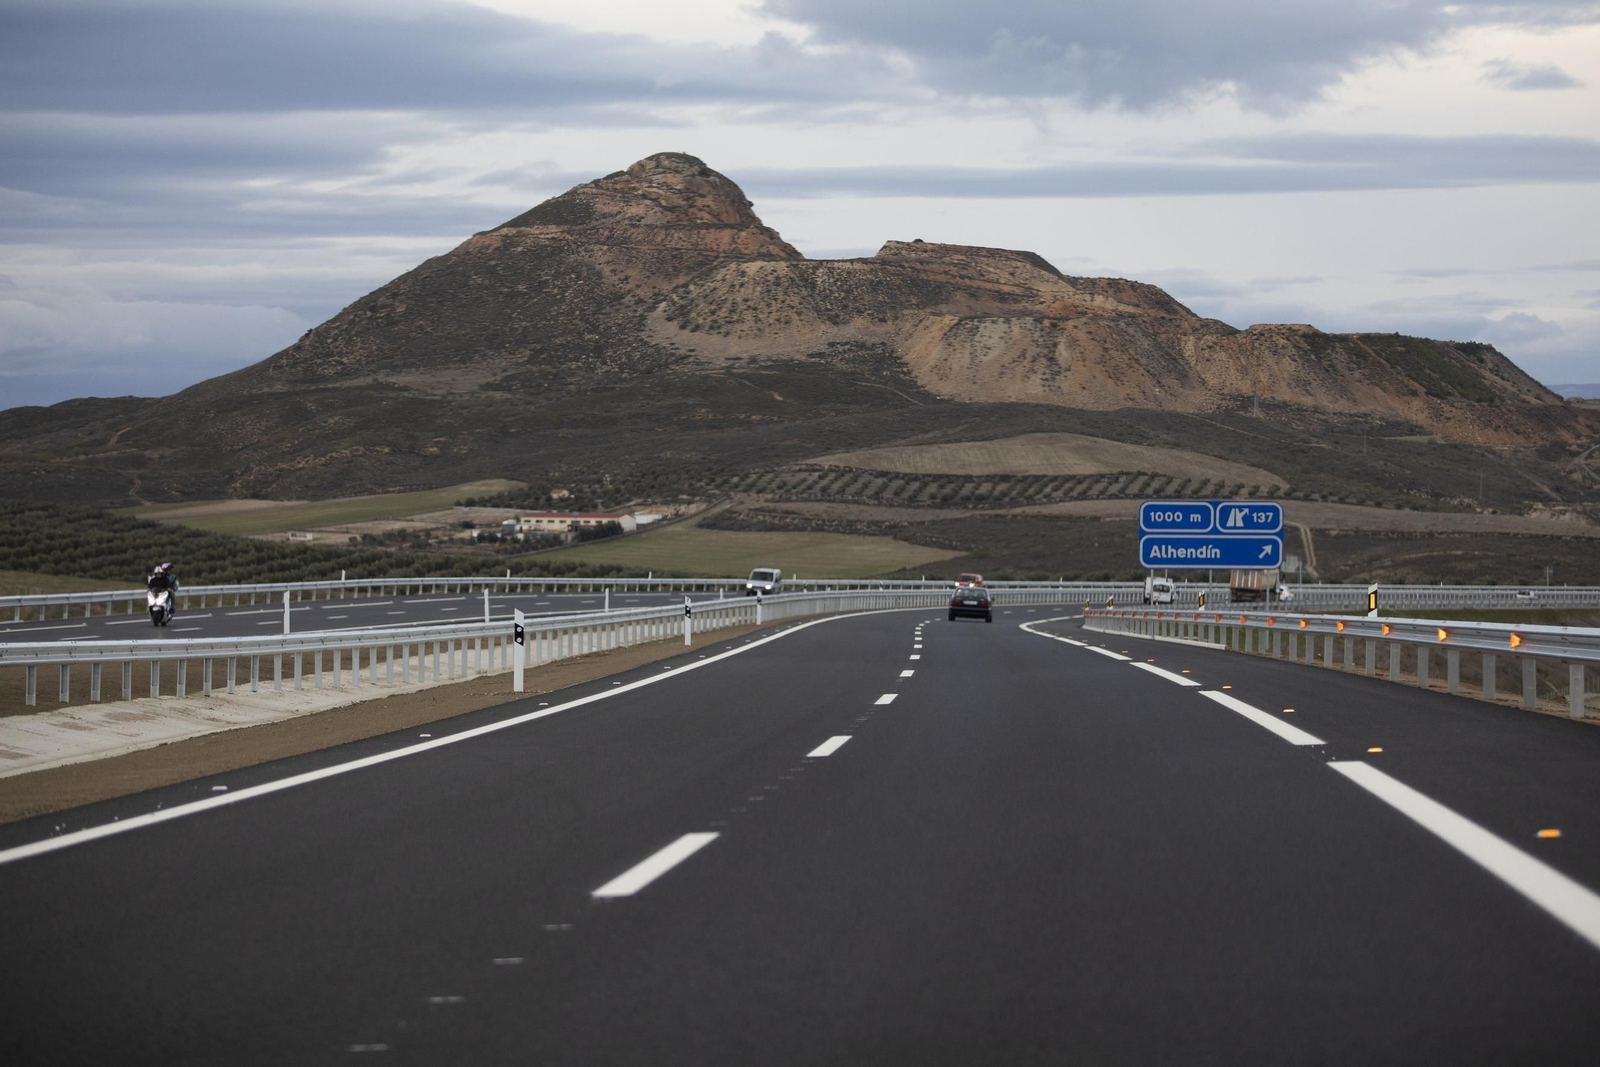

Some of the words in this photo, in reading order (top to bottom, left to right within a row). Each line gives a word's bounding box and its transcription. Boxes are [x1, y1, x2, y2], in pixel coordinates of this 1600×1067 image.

[1149, 511, 1183, 522] 1000
[1189, 513, 1201, 522] m
[1252, 512, 1274, 523] 137
[1149, 544, 1221, 559] Alhendín
